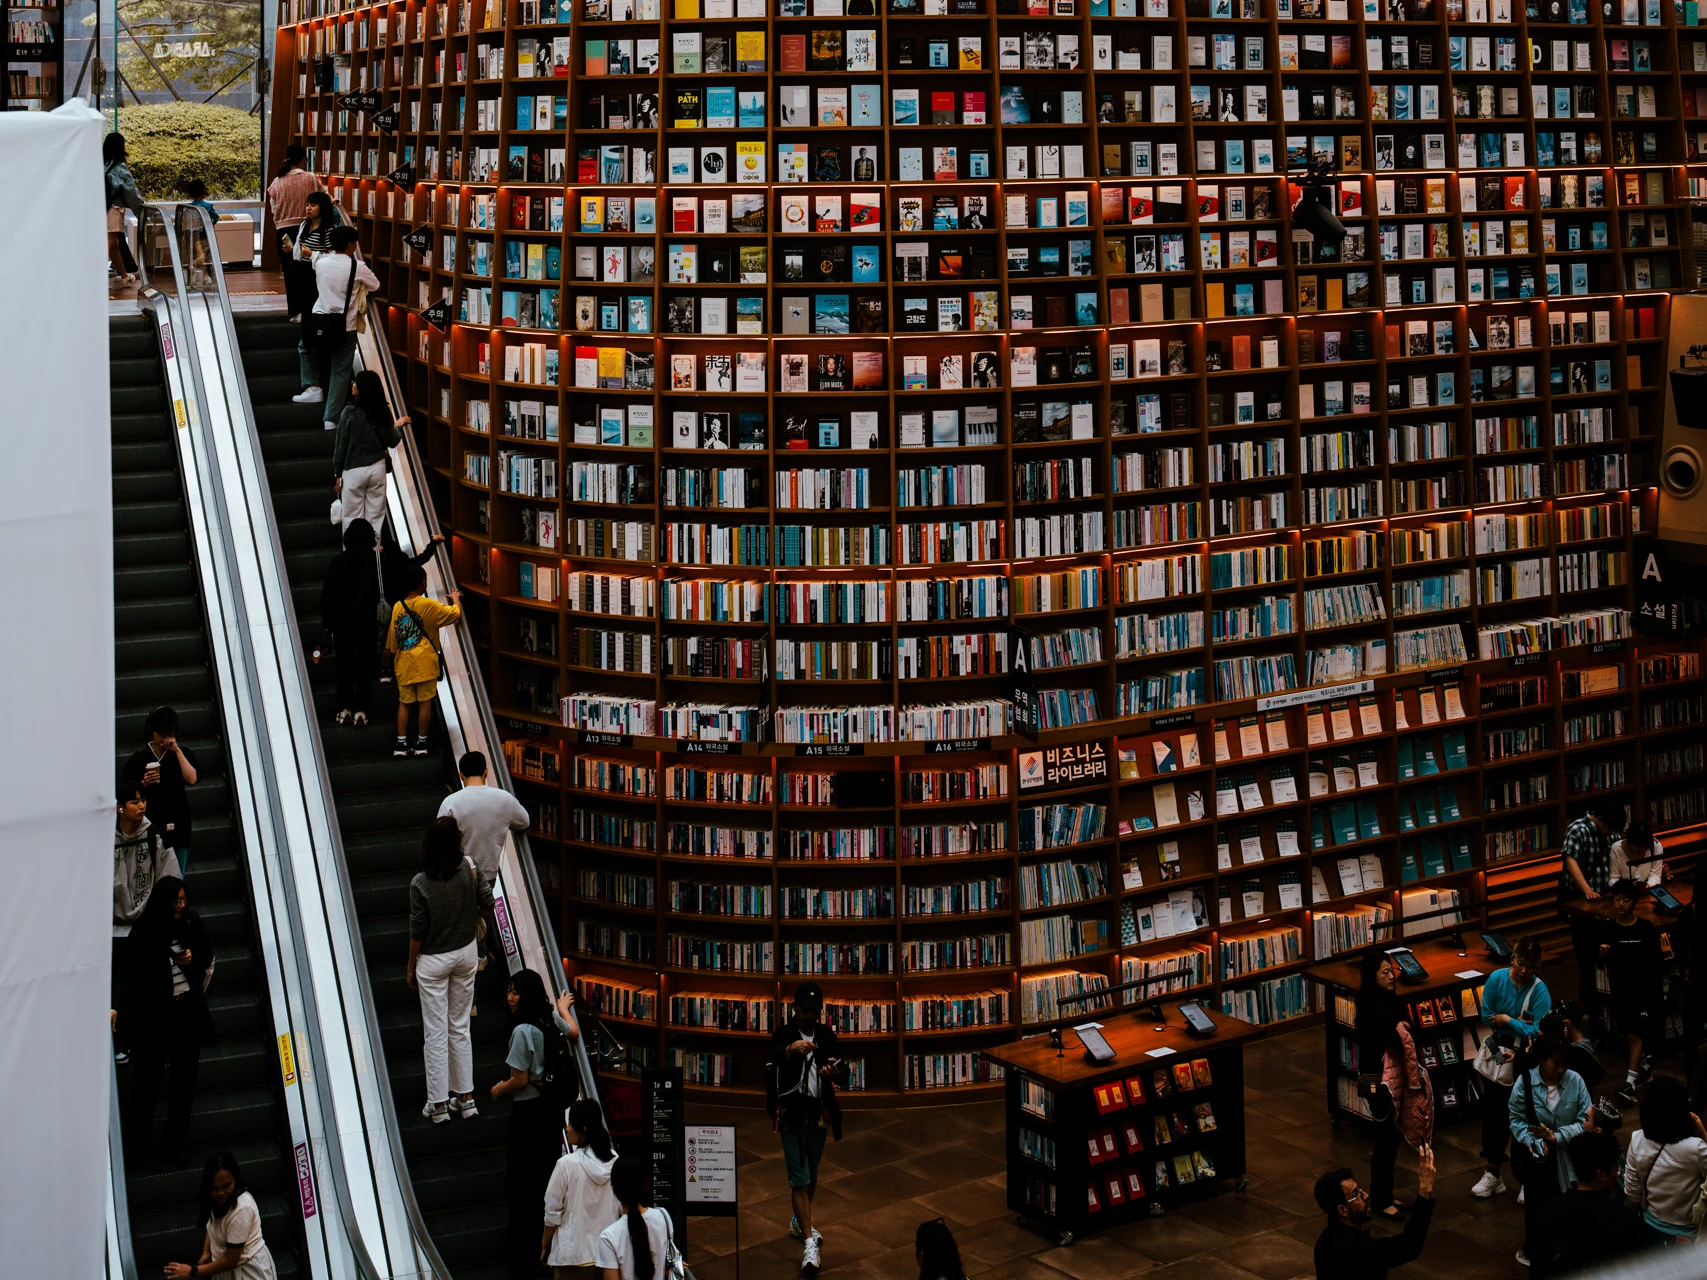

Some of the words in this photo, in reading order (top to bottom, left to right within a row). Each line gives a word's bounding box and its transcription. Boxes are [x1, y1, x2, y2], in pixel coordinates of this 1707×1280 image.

[361, 96, 375, 106] 주의
[677, 95, 698, 104] PATH
[377, 115, 392, 125] 주의
[394, 172, 408, 182] 주의
[410, 234, 426, 245] 주의
[906, 314, 927, 324] 군함도
[819, 381, 831, 389] ELON
[831, 381, 843, 389] MUSK
[1641, 552, 1662, 582] A
[1640, 601, 1666, 620] 소설
[1014, 637, 1028, 675] A
[1513, 656, 1525, 665] A22
[585, 734, 600, 744] A13
[601, 734, 622, 742] 외국소설
[686, 742, 703, 752] A14
[705, 743, 729, 751] 외국소설
[805, 746, 823, 755] A15
[935, 742, 952, 753] A16
[954, 740, 978, 748] 외국소설
[1046, 742, 1105, 767] 비즈니스
[1047, 760, 1107, 784] 라이브러리
[653, 1081, 661, 1089] 1F
[652, 1152, 666, 1160] B1F
